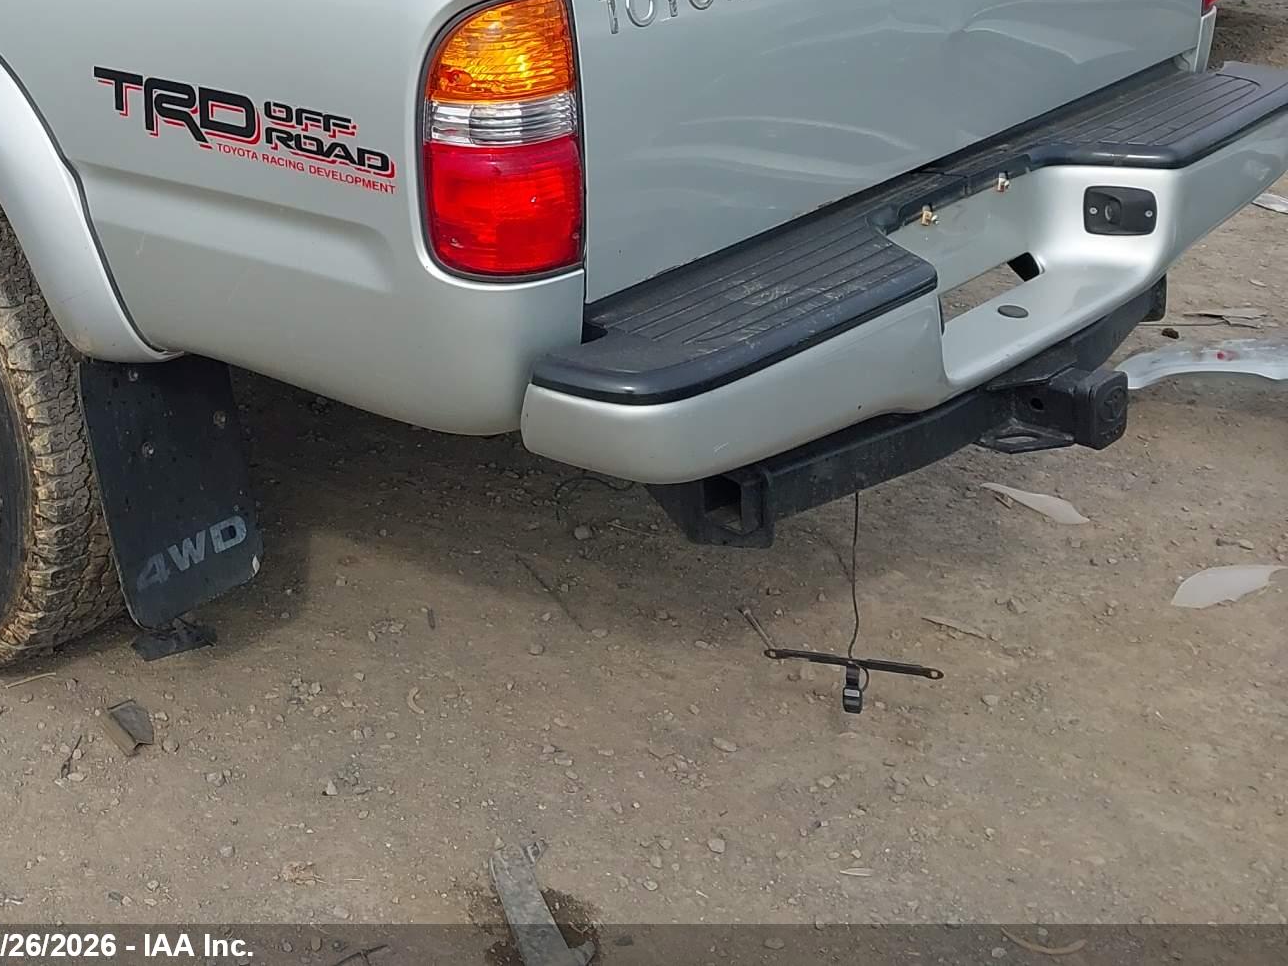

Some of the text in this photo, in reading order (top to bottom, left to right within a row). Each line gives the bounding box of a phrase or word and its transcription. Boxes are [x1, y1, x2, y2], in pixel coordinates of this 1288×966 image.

[93, 65, 357, 150] TRD OFF
[216, 142, 397, 194] TOYOTA RACING DEVELOPMENT
[264, 126, 396, 179] ROAD
[135, 514, 248, 593] 4WD
